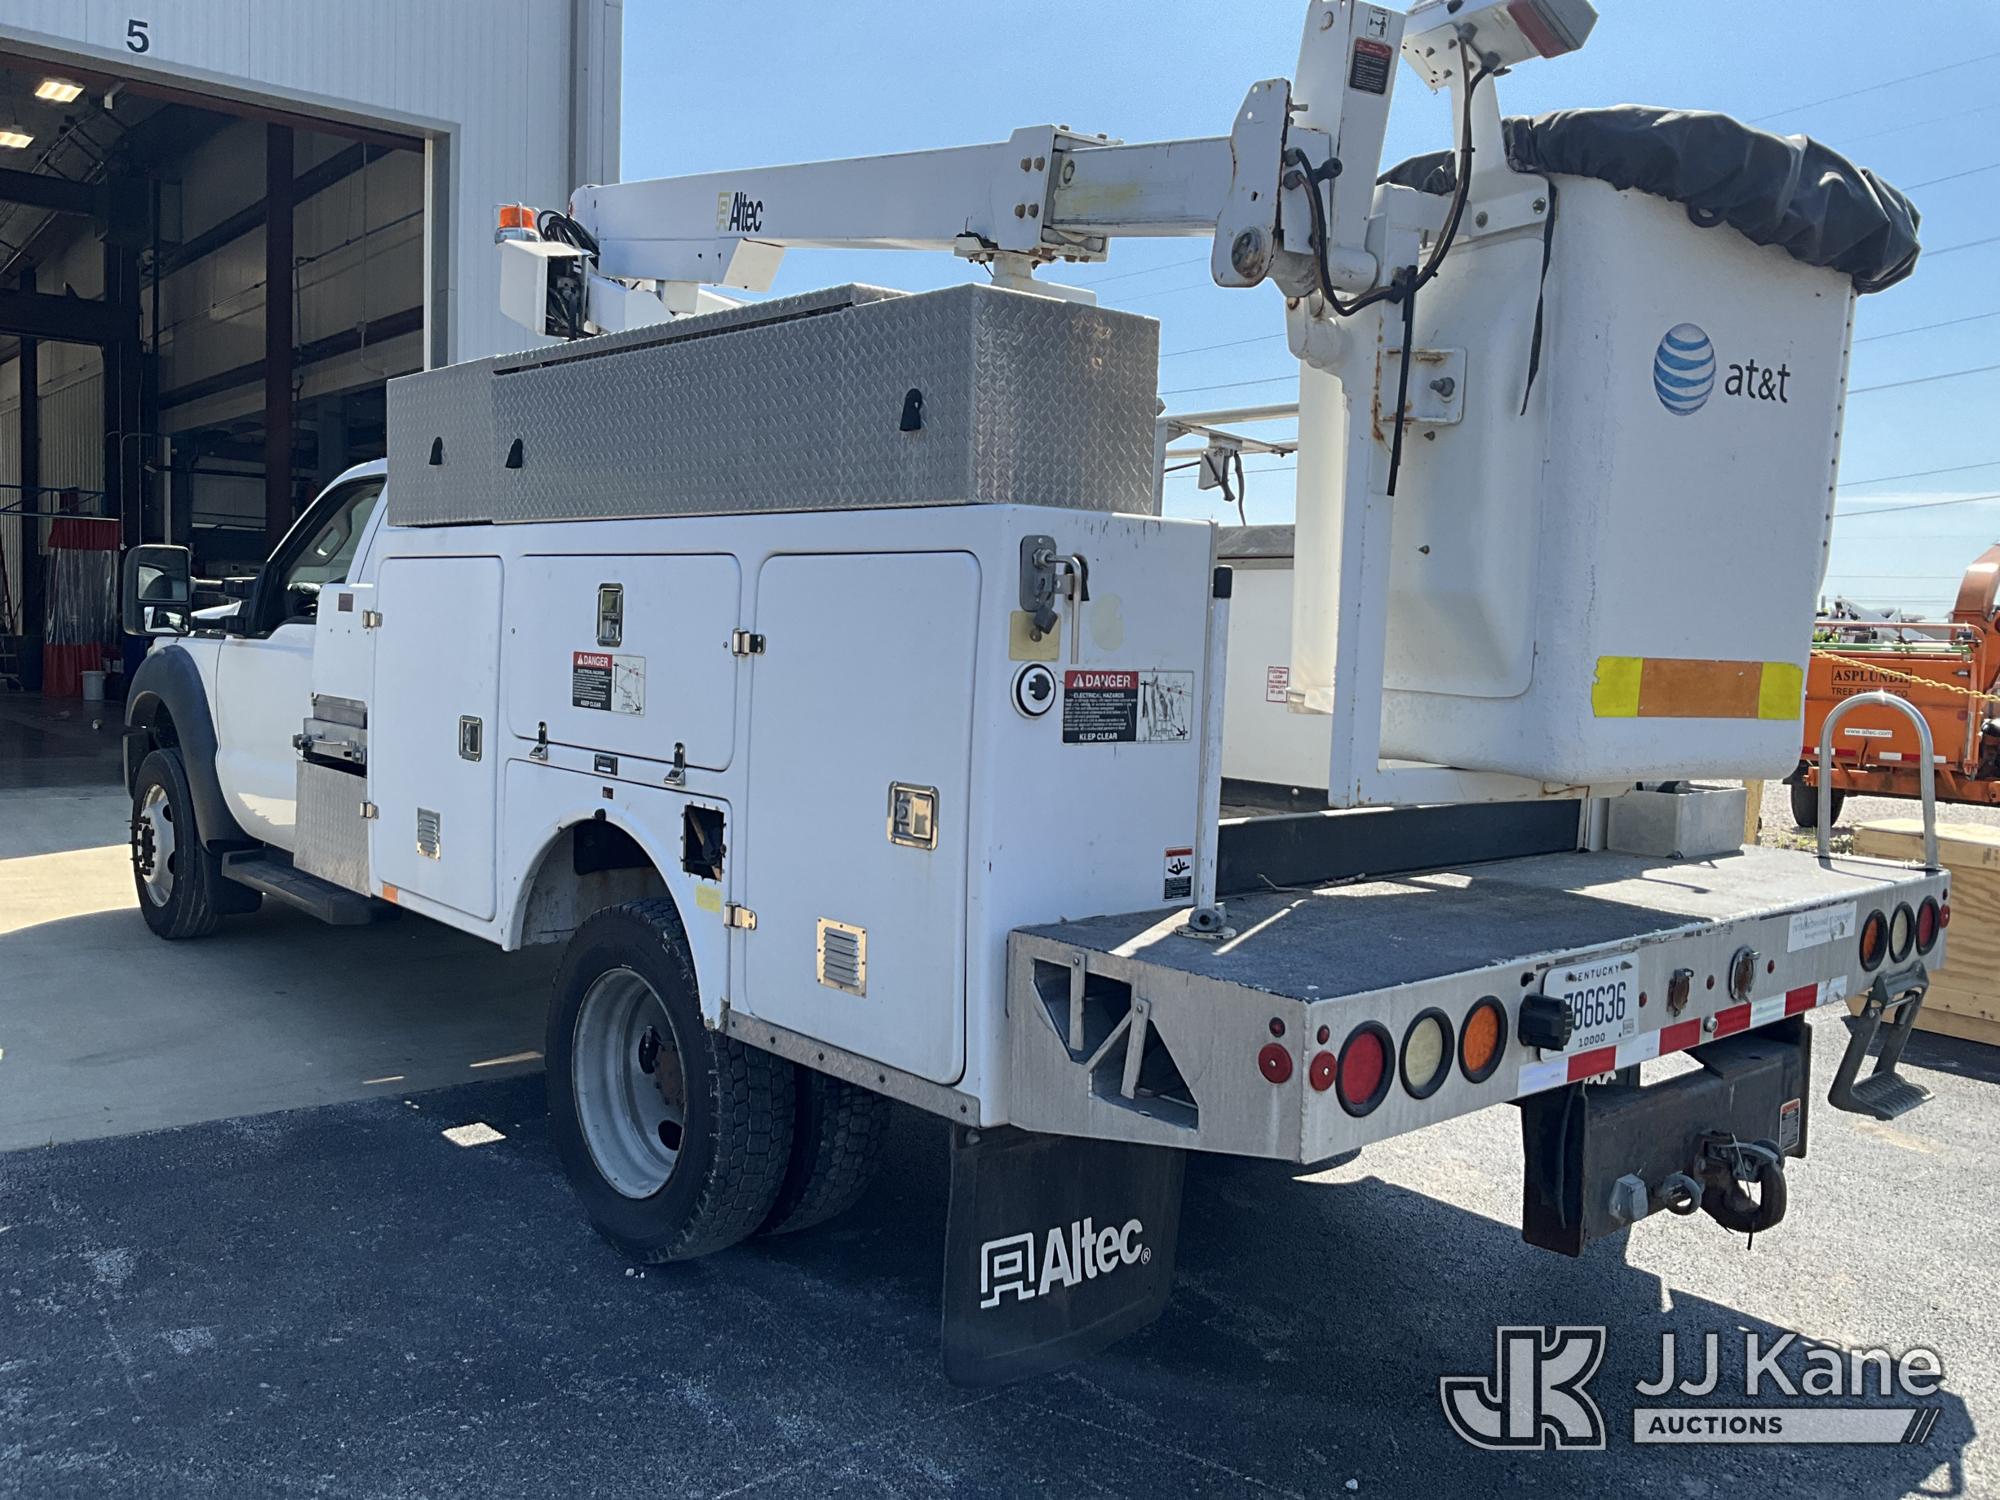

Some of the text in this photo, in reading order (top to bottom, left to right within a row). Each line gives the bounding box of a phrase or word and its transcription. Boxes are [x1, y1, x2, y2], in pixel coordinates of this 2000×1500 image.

[126, 19, 149, 53] 5
[728, 191, 764, 232] Altec
[1725, 358, 1791, 403] at&t
[583, 655, 609, 667] DANGER
[1085, 674, 1132, 688] DANGER
[1832, 687, 1854, 696] TREE
[1096, 731, 1118, 740] CLEAR
[1568, 965, 1620, 982] ENTUCKY
[1578, 1032, 1606, 1048] 10000
